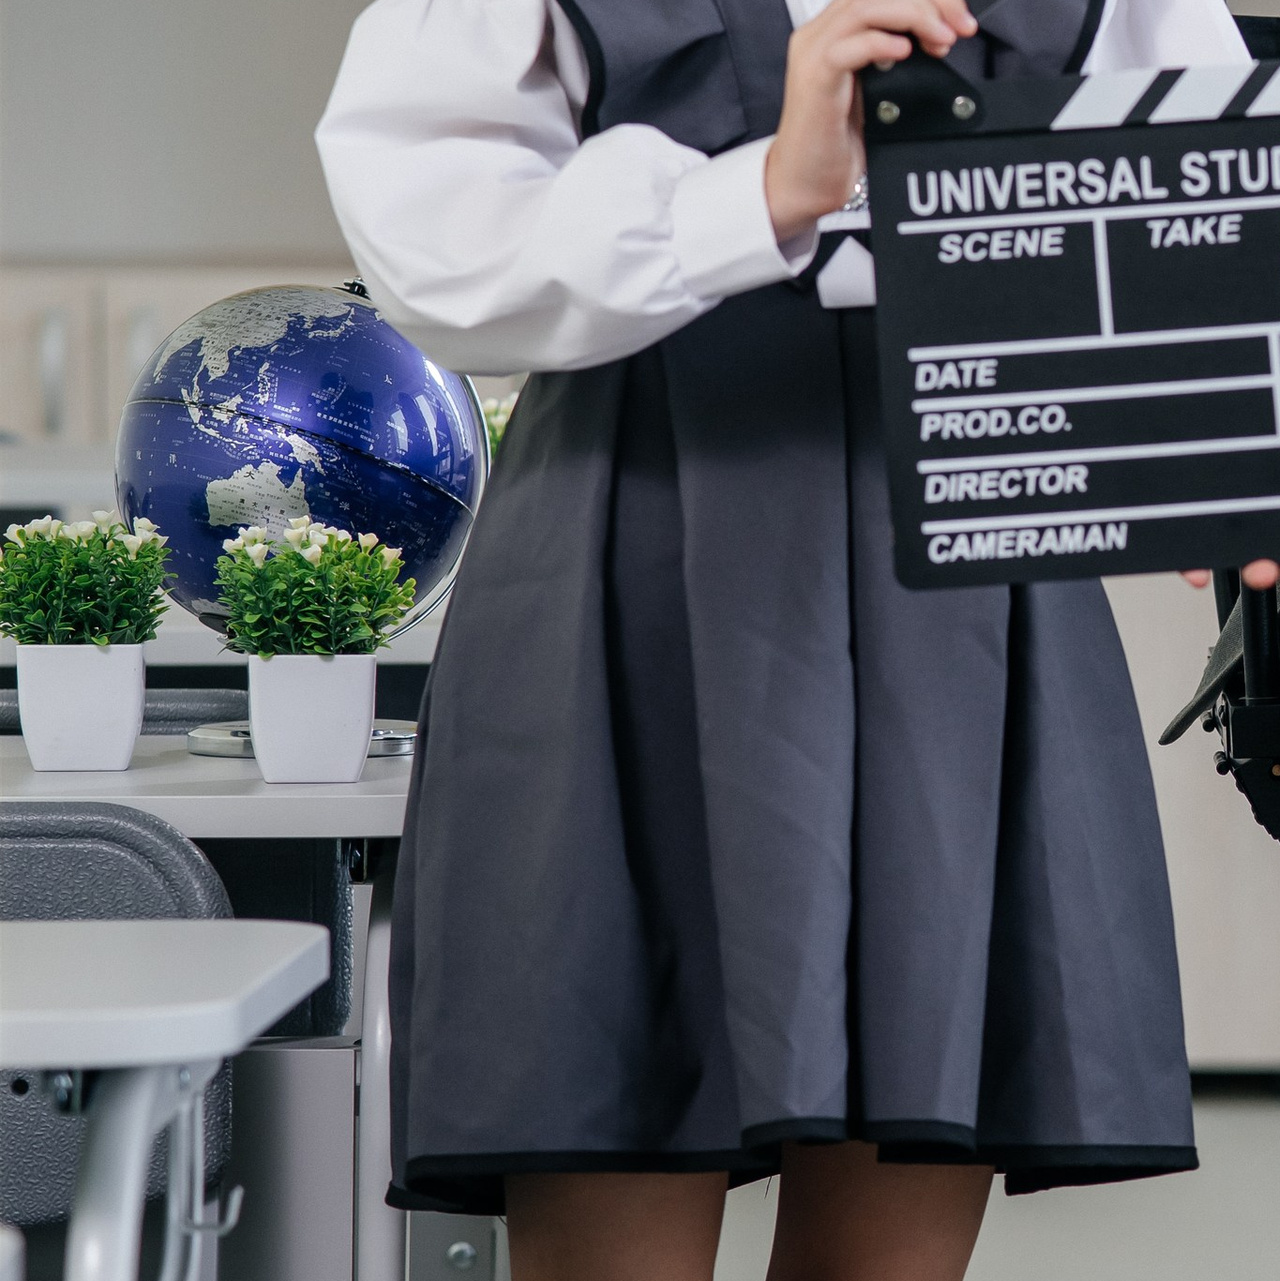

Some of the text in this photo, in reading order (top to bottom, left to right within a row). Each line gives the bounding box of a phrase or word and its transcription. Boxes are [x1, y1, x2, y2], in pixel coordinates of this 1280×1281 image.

[907, 156, 1169, 216] UNIVERSAL
[938, 227, 1065, 263] SCENE
[1147, 214, 1242, 248] TAKE
[915, 359, 998, 391] DATE
[925, 465, 1088, 503] DIRECTOR
[928, 522, 1127, 563] CAMERAMAN
